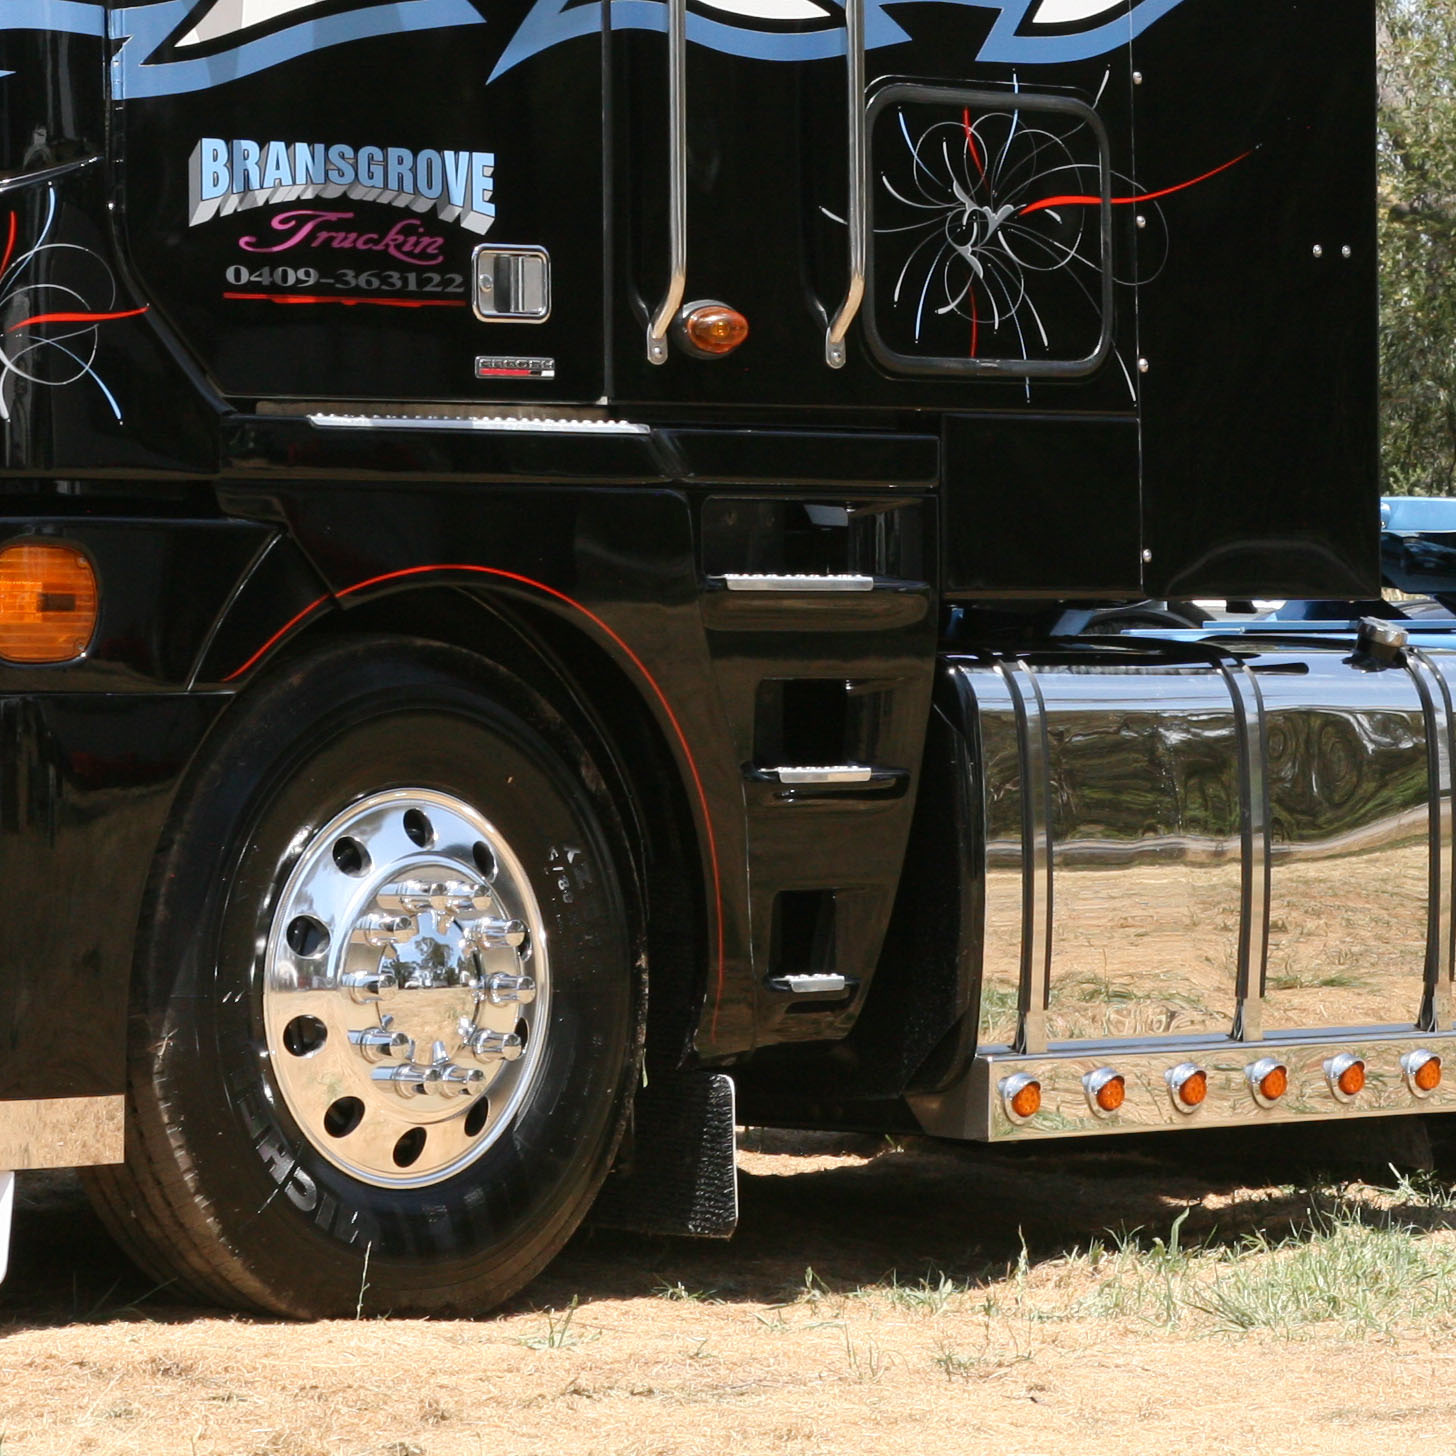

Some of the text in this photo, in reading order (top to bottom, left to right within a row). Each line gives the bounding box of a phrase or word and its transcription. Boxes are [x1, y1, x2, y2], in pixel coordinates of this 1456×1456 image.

[189, 137, 496, 234] BRANSGROVE
[238, 210, 444, 265] Truckin
[225, 264, 465, 292] 0409-363122
